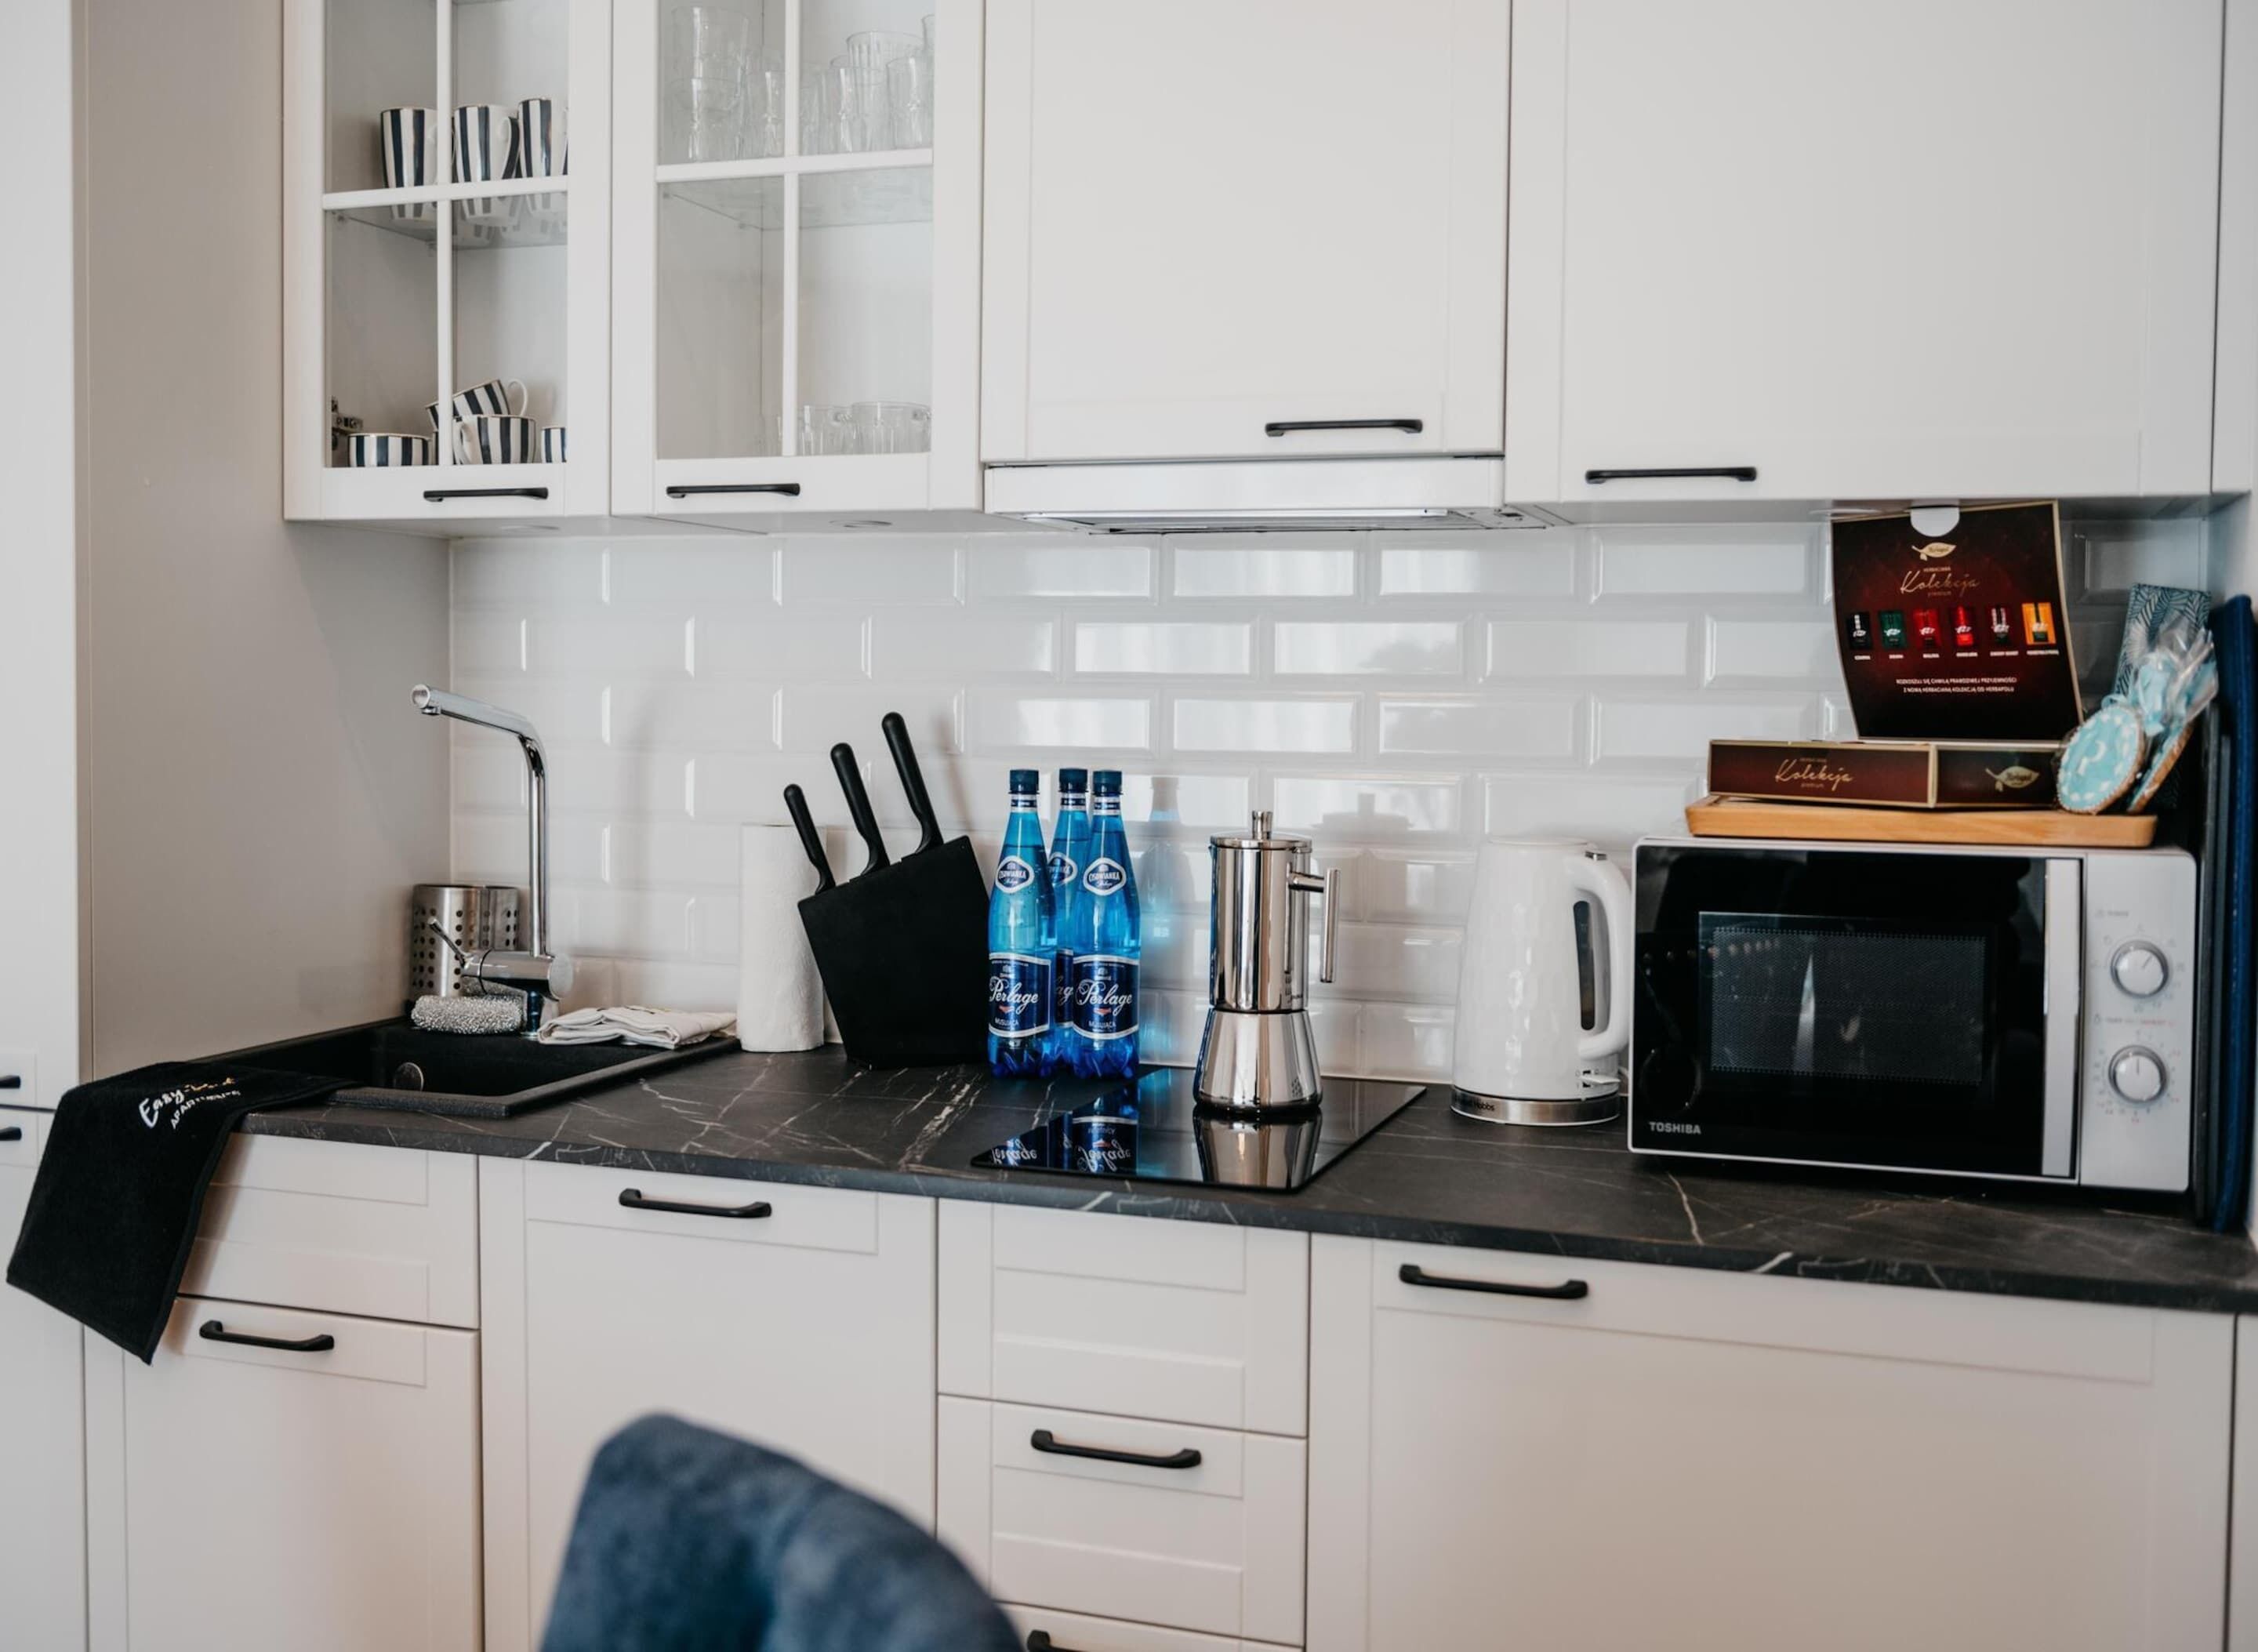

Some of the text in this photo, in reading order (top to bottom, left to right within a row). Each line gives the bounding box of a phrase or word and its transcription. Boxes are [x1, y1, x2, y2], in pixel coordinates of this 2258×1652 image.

[1900, 571, 1980, 597] Kolekcja
[1775, 758, 1853, 792] Kolekcja
[989, 976, 1039, 1015] Perlage
[1075, 978, 1133, 1016] Perlage
[139, 1088, 185, 1129] Easy
[1649, 1121, 1701, 1135] TOSHIBA
